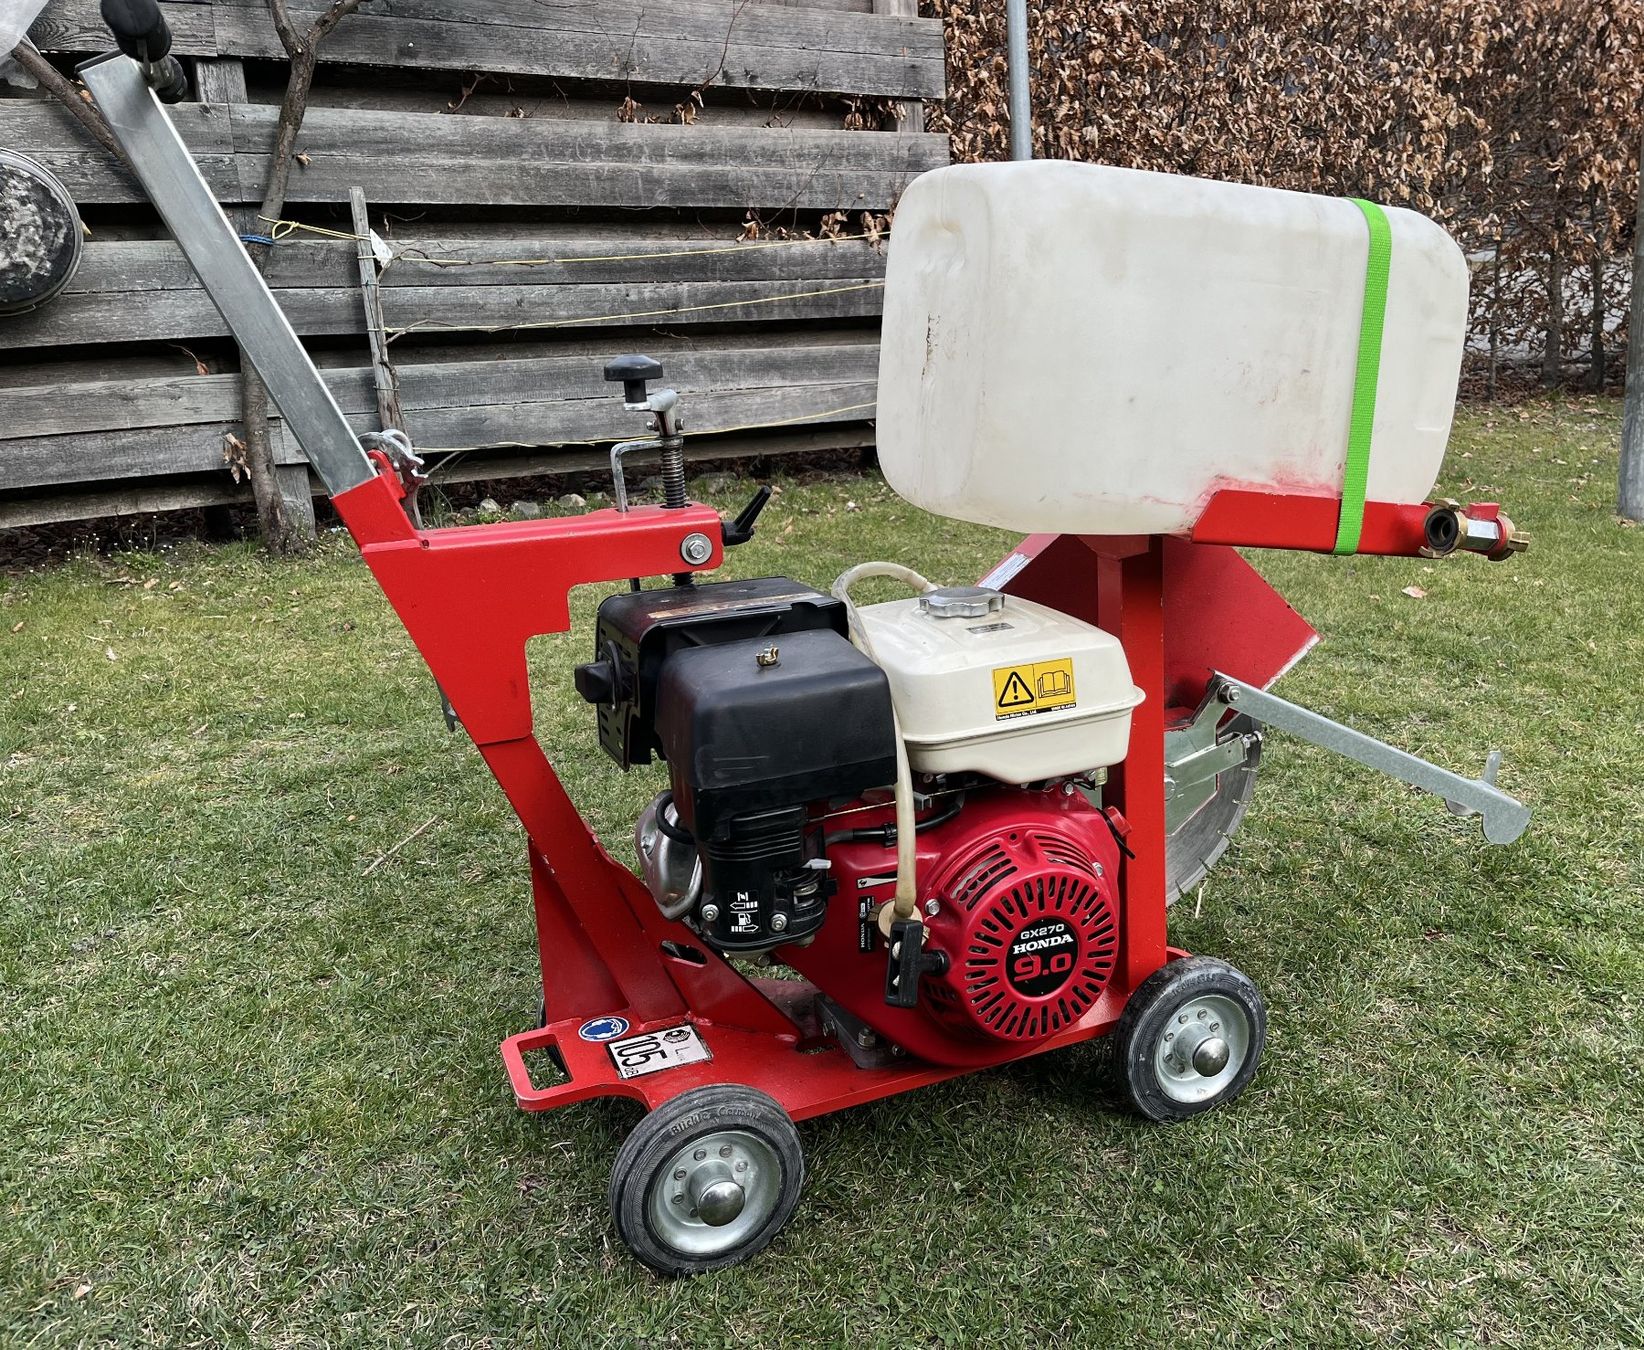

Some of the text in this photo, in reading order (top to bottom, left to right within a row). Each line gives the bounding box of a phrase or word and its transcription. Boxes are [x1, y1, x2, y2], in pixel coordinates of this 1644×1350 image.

[1012, 933, 1074, 955] HONDA
[1020, 923, 1065, 940] GX270
[1013, 953, 1072, 982] 9.0
[614, 1035, 668, 1067] 105
